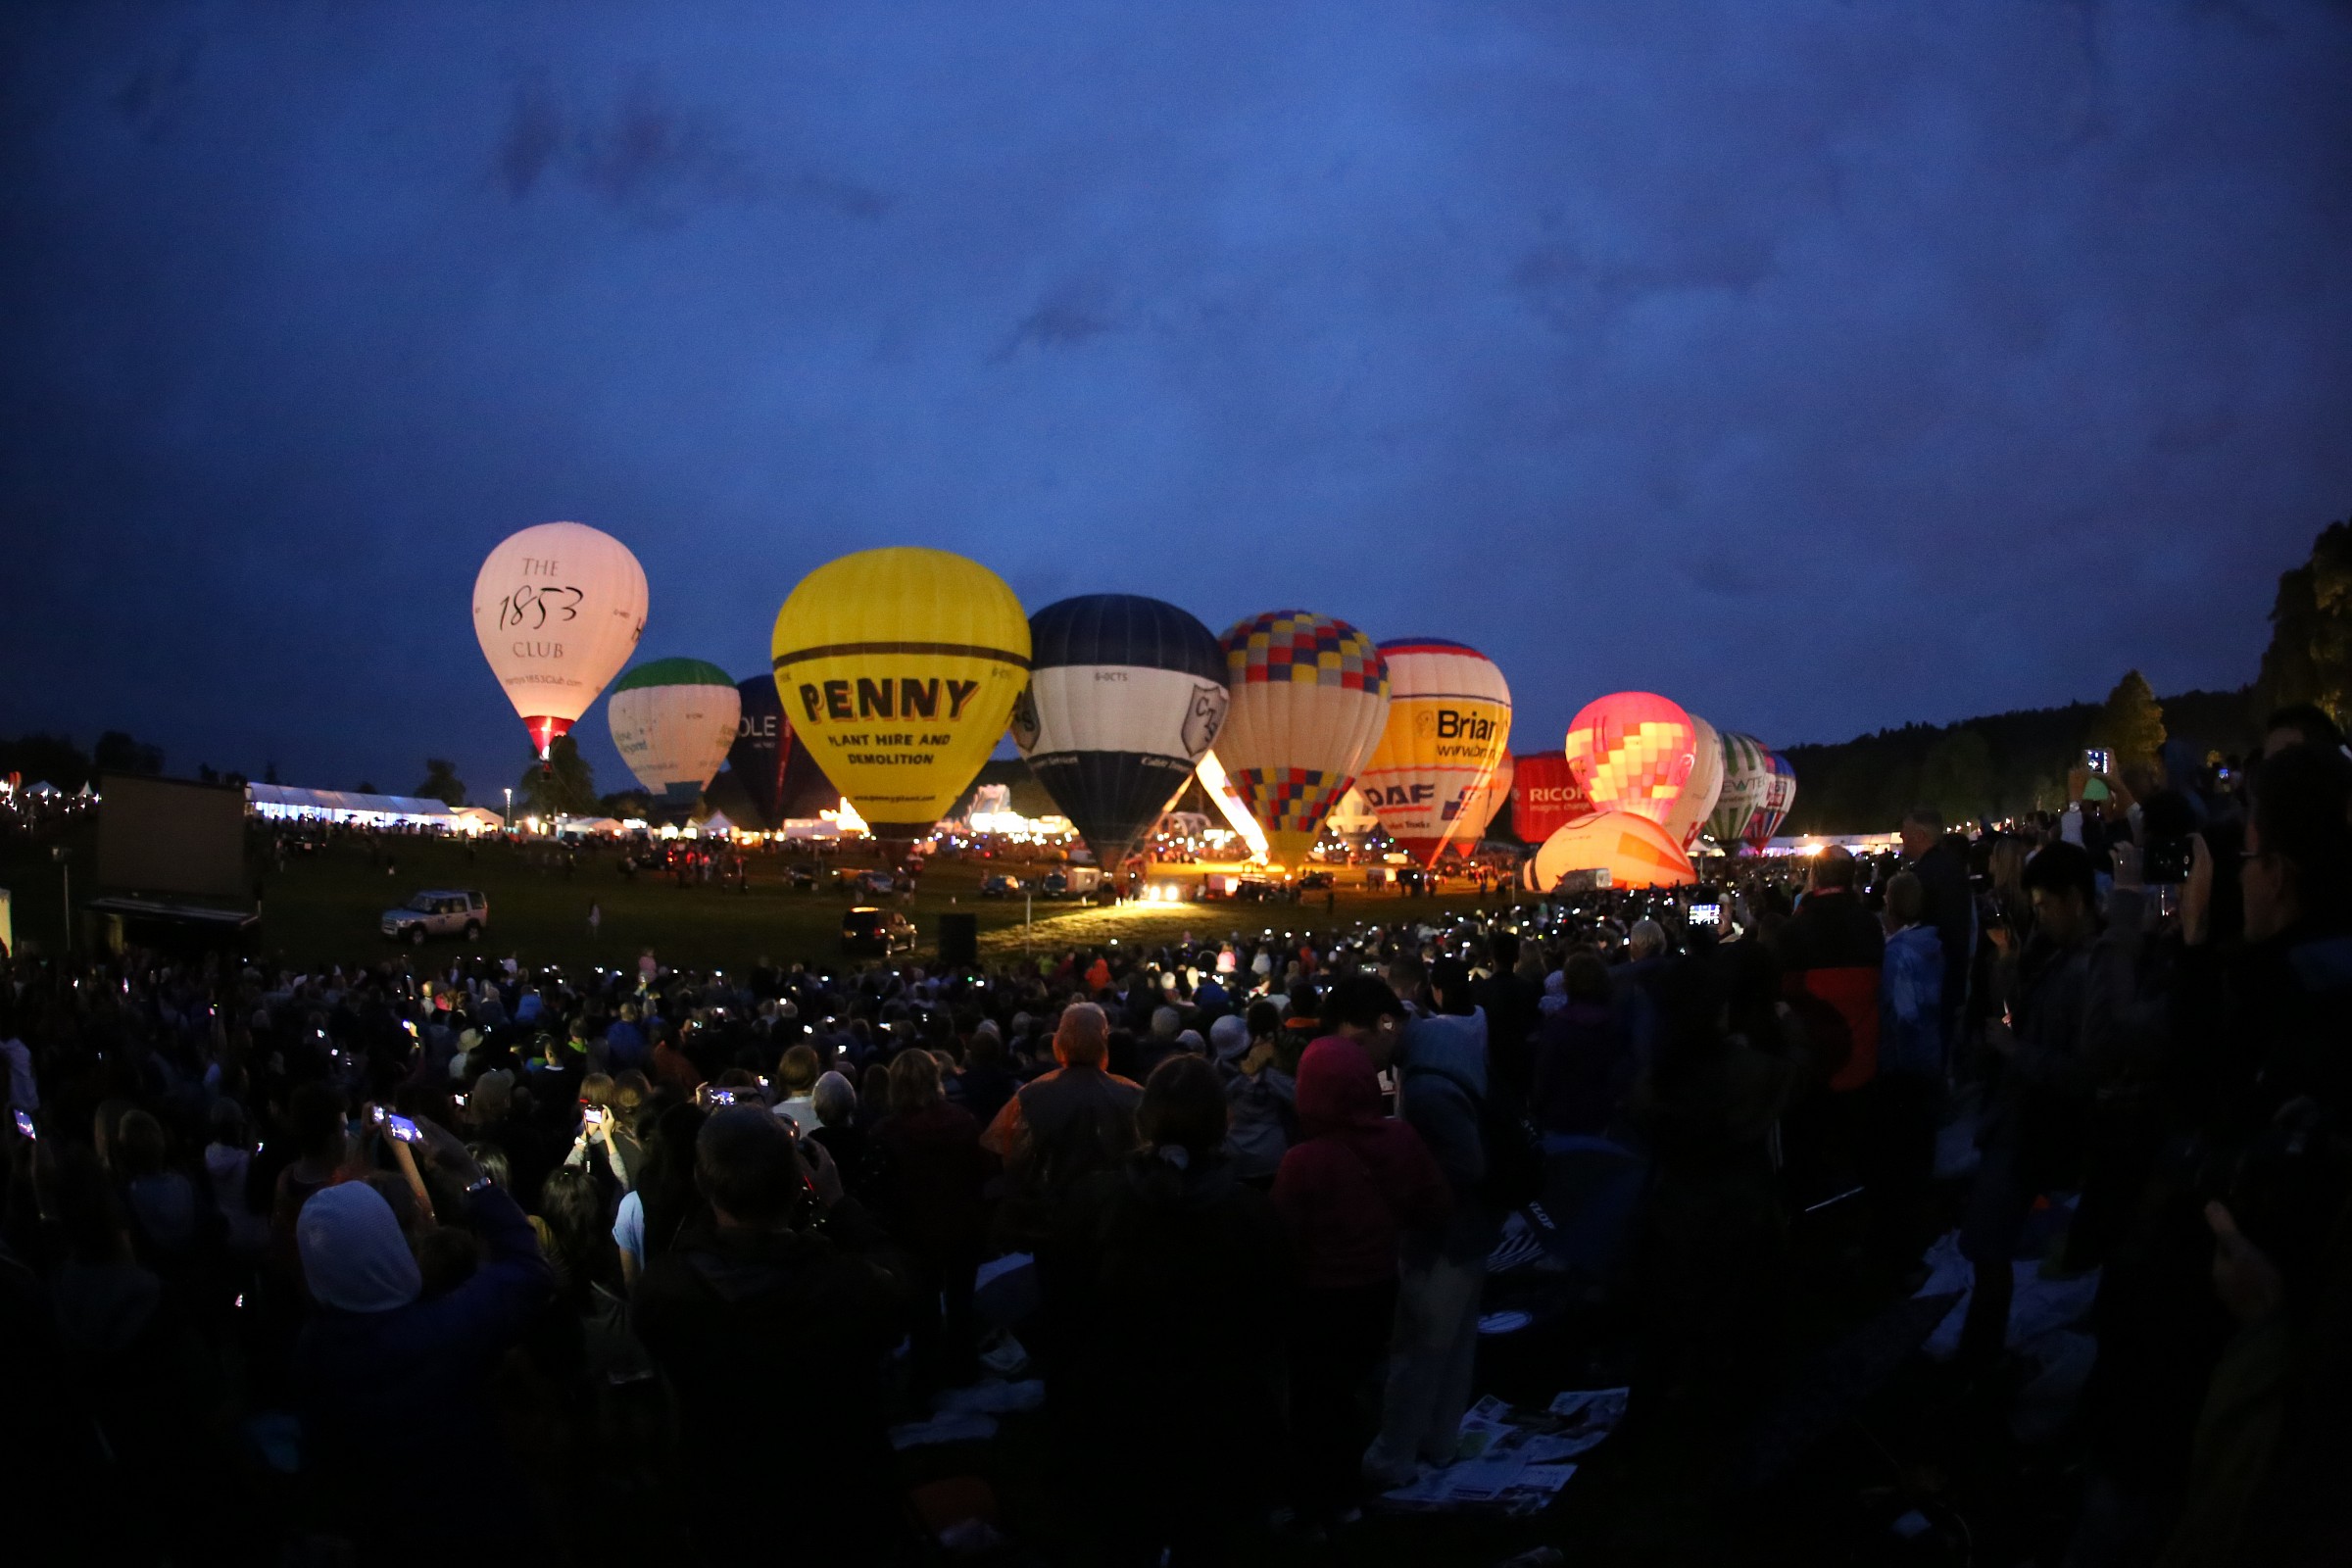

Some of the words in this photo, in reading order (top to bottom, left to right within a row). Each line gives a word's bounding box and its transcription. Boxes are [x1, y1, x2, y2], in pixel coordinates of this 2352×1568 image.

[522, 558, 560, 576] THE
[500, 585, 584, 631] 1853
[513, 641, 564, 658] CLUB
[799, 677, 981, 724] PENNY
[828, 733, 870, 747] PLANT
[874, 733, 913, 746] HIRE
[918, 733, 952, 746] AND
[847, 754, 934, 765] DEMOLITION
[1363, 783, 1436, 808] DAF
